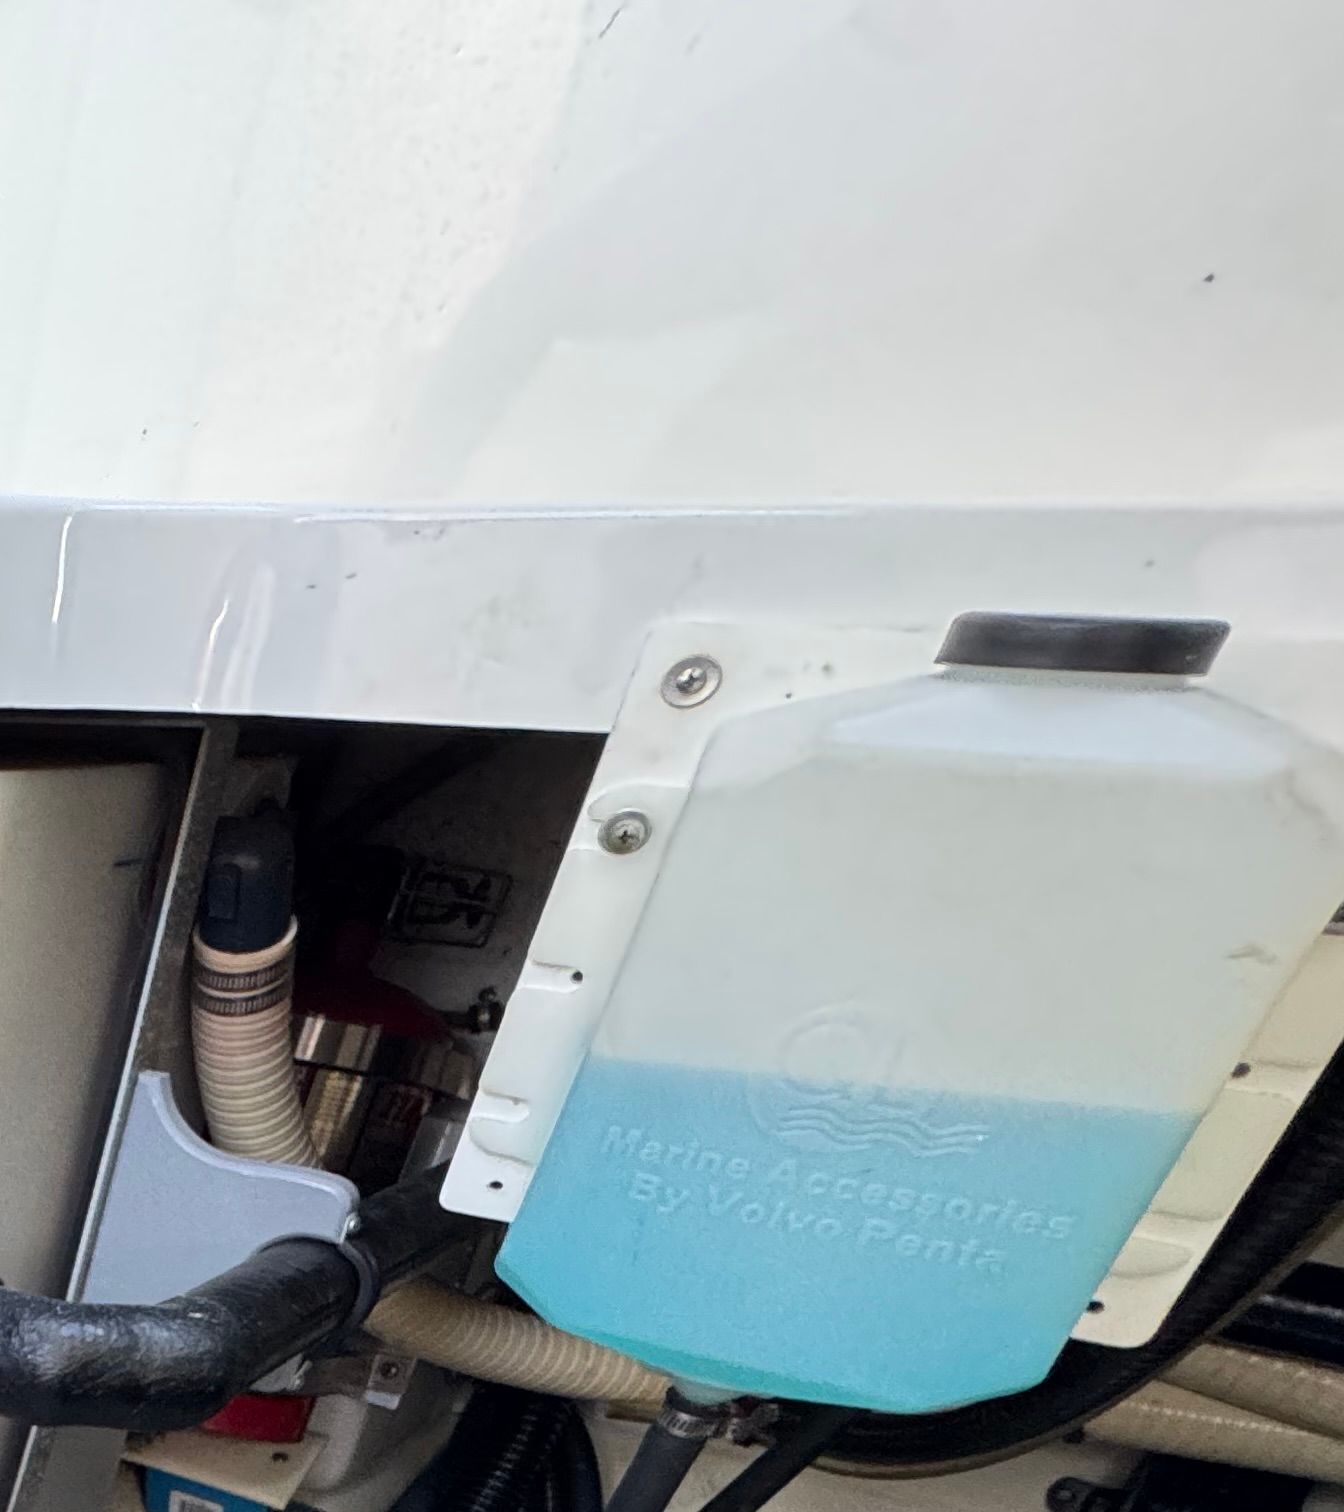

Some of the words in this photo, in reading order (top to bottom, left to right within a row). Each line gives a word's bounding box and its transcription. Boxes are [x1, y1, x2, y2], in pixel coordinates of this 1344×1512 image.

[602, 1125, 751, 1178] Marine
[767, 1158, 1077, 1240] Accessories
[629, 1171, 689, 1214] By
[709, 1185, 843, 1238] Volvo
[859, 1217, 1007, 1272] Penta
